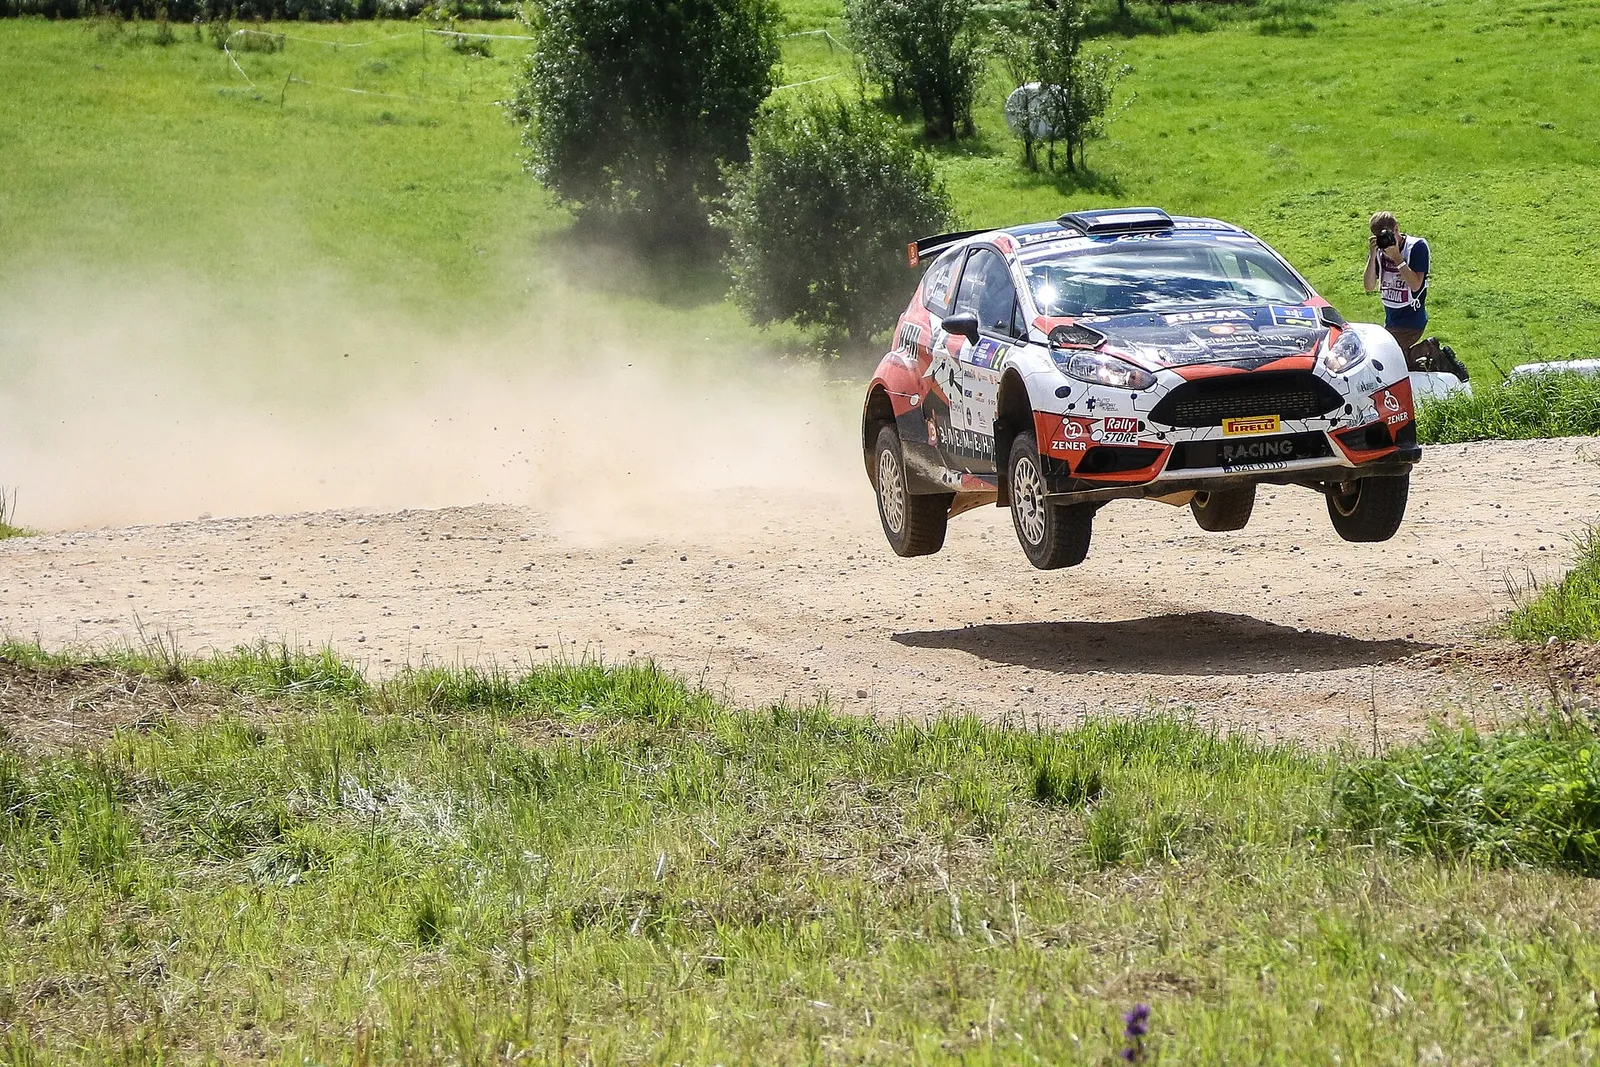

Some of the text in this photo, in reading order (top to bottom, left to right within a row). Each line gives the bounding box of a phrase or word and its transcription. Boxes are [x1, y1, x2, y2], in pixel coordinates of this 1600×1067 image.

[1165, 309, 1252, 326] RPM
[1228, 418, 1275, 433] PIRELLI
[1387, 411, 1409, 425] ZENER
[1106, 418, 1135, 434] Rally
[1052, 440, 1087, 451] ZENER
[1103, 433, 1137, 443] STORE
[1223, 440, 1294, 459] RACING
